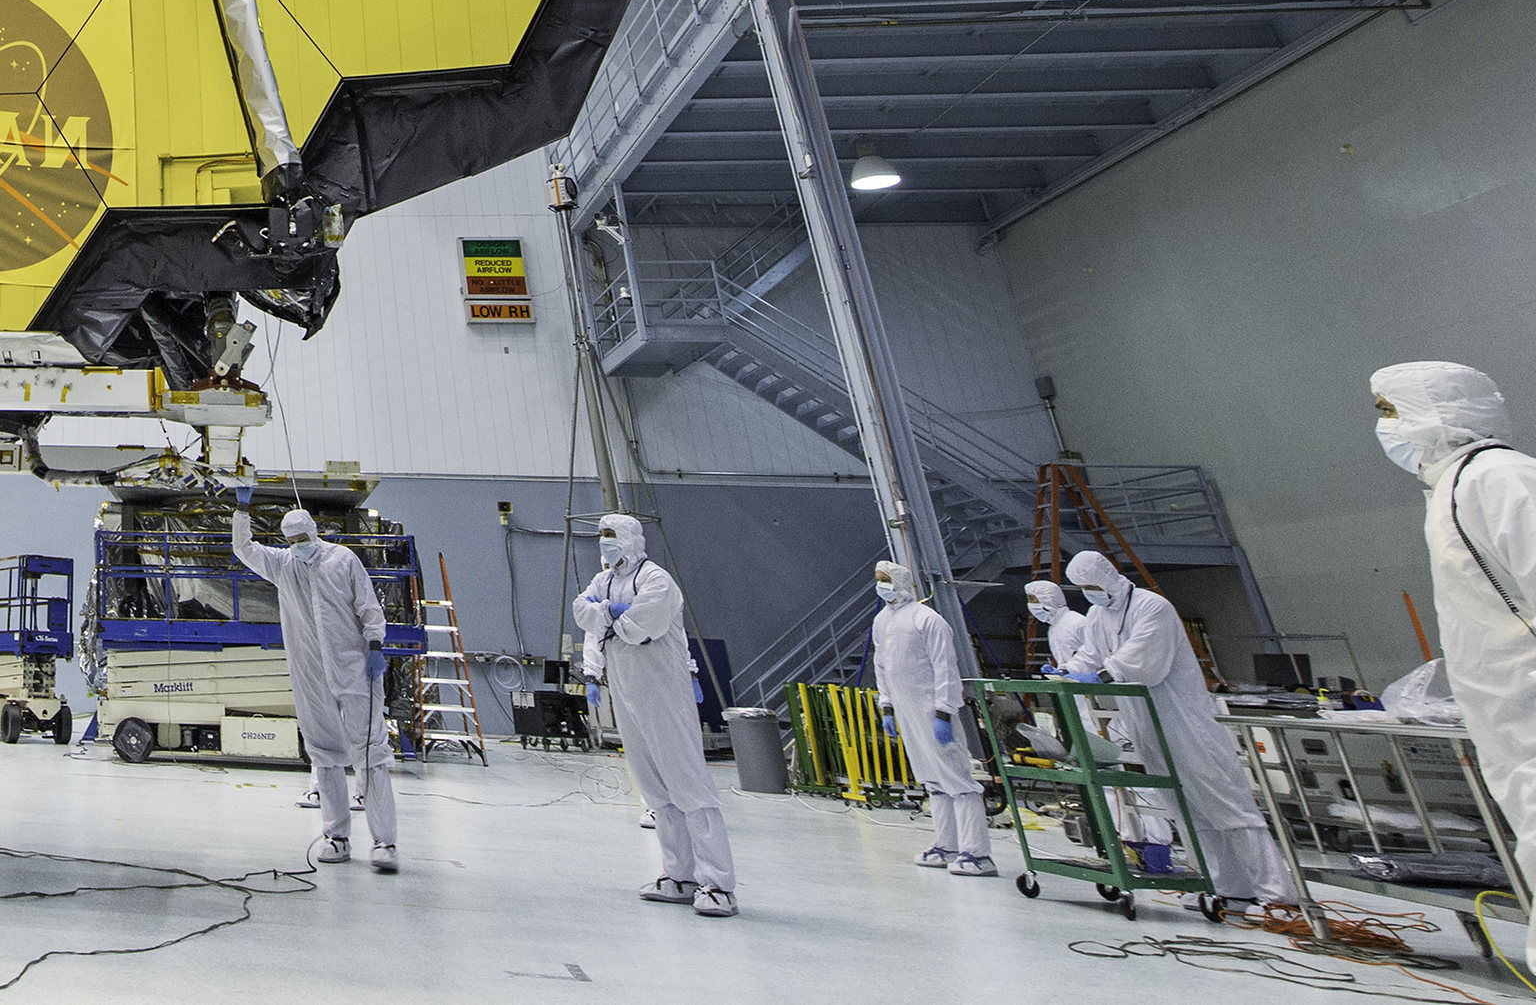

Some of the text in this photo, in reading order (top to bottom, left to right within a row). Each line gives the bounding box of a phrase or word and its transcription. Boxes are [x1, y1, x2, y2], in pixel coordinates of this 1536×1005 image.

[471, 305, 531, 318] LOW RH
[154, 682, 194, 693] Marklift
